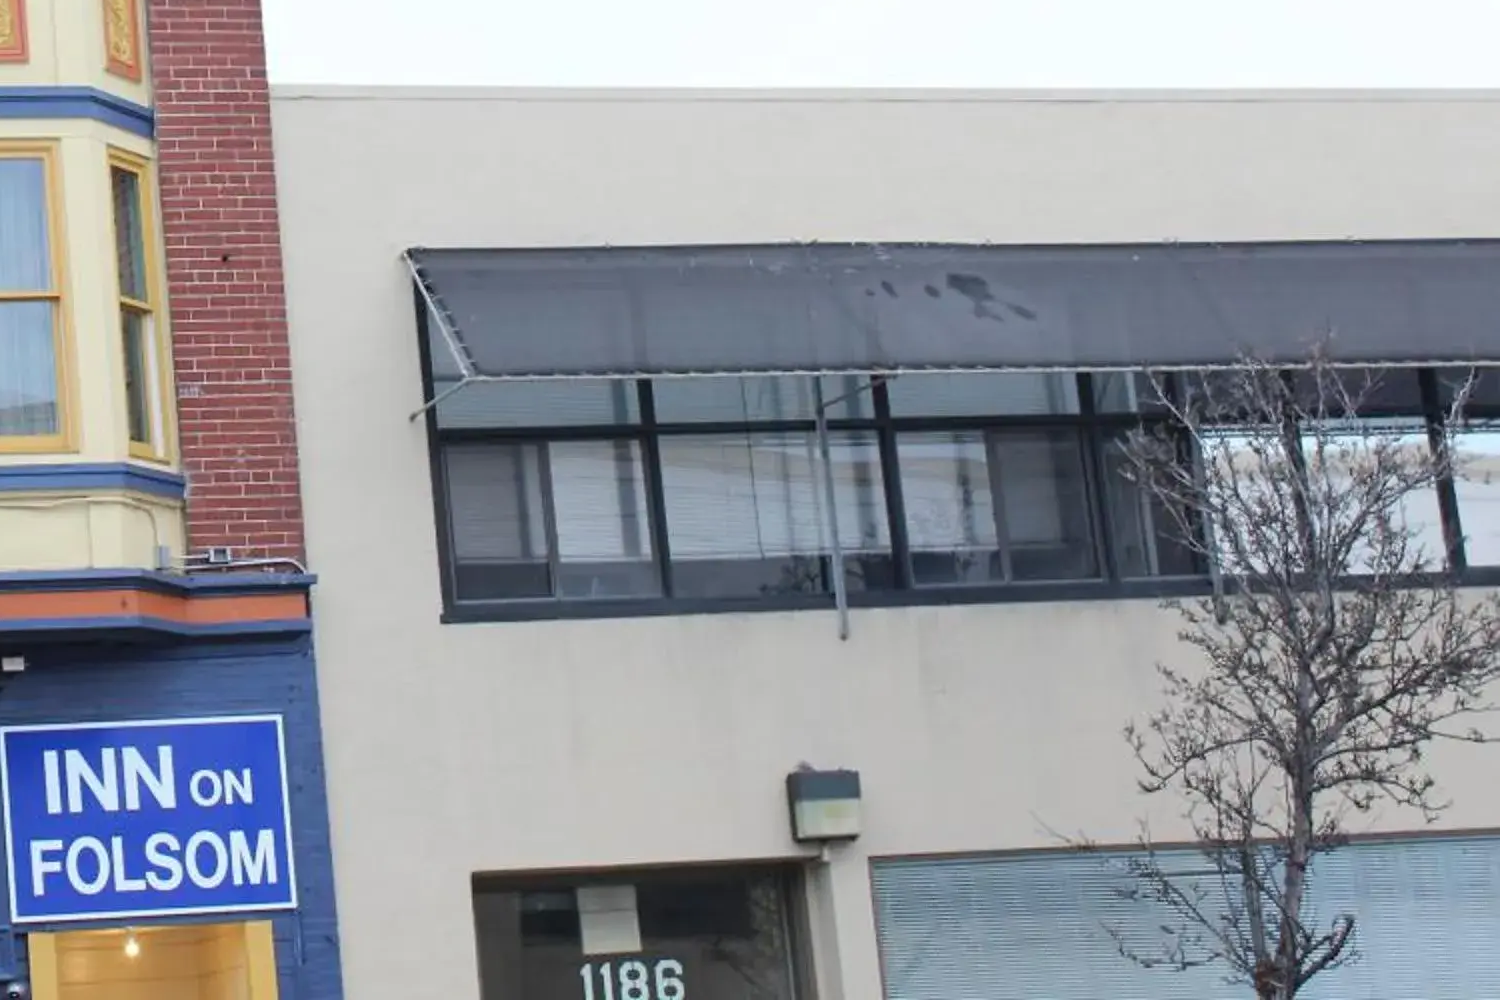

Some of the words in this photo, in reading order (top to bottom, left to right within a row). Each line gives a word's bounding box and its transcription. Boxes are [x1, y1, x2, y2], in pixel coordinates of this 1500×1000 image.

[43, 745, 177, 815] INN
[189, 767, 253, 808] ON
[29, 829, 277, 897] FOLSOM
[580, 959, 685, 1000] 1186
